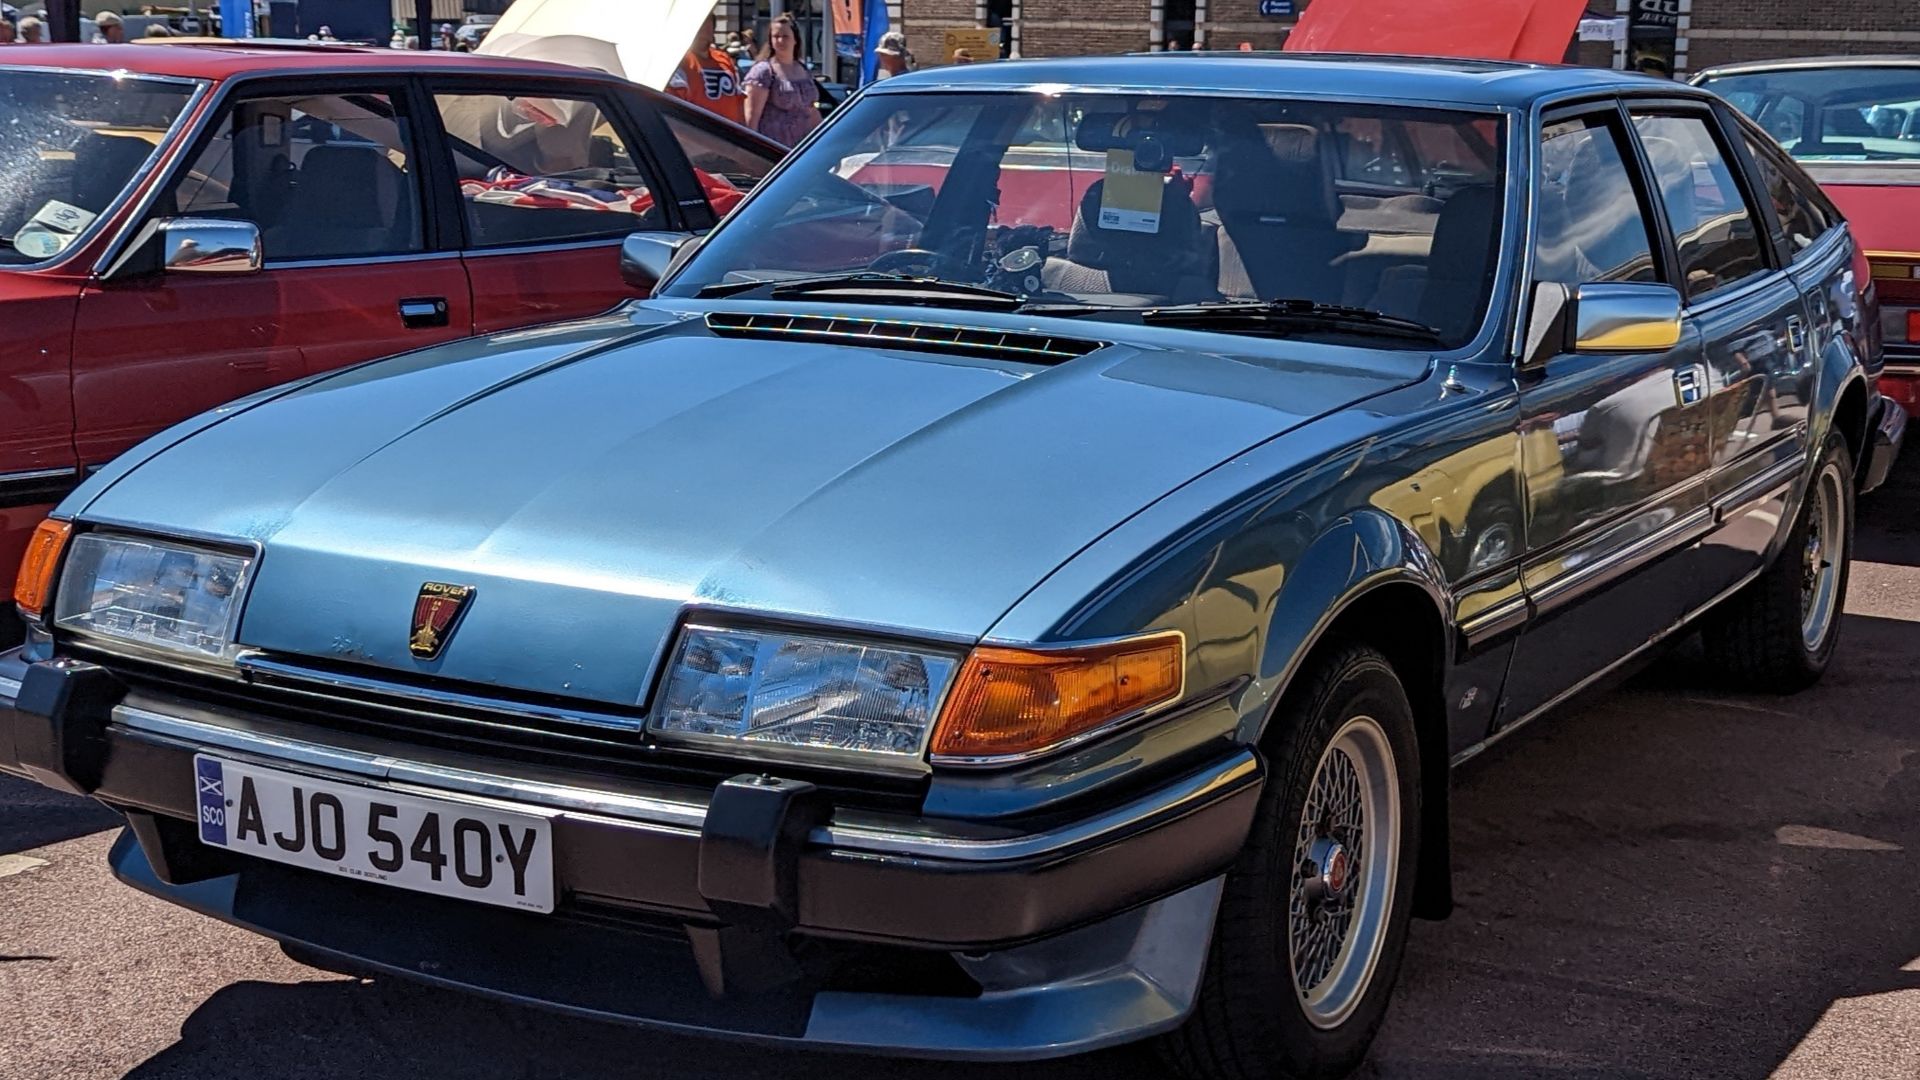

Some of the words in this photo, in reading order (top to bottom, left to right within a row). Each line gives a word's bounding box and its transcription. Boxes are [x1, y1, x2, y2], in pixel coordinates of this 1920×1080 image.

[424, 583, 468, 596] ROVER
[203, 806, 224, 827] SCO
[237, 776, 345, 862] AJO
[368, 802, 537, 896] 540Y
